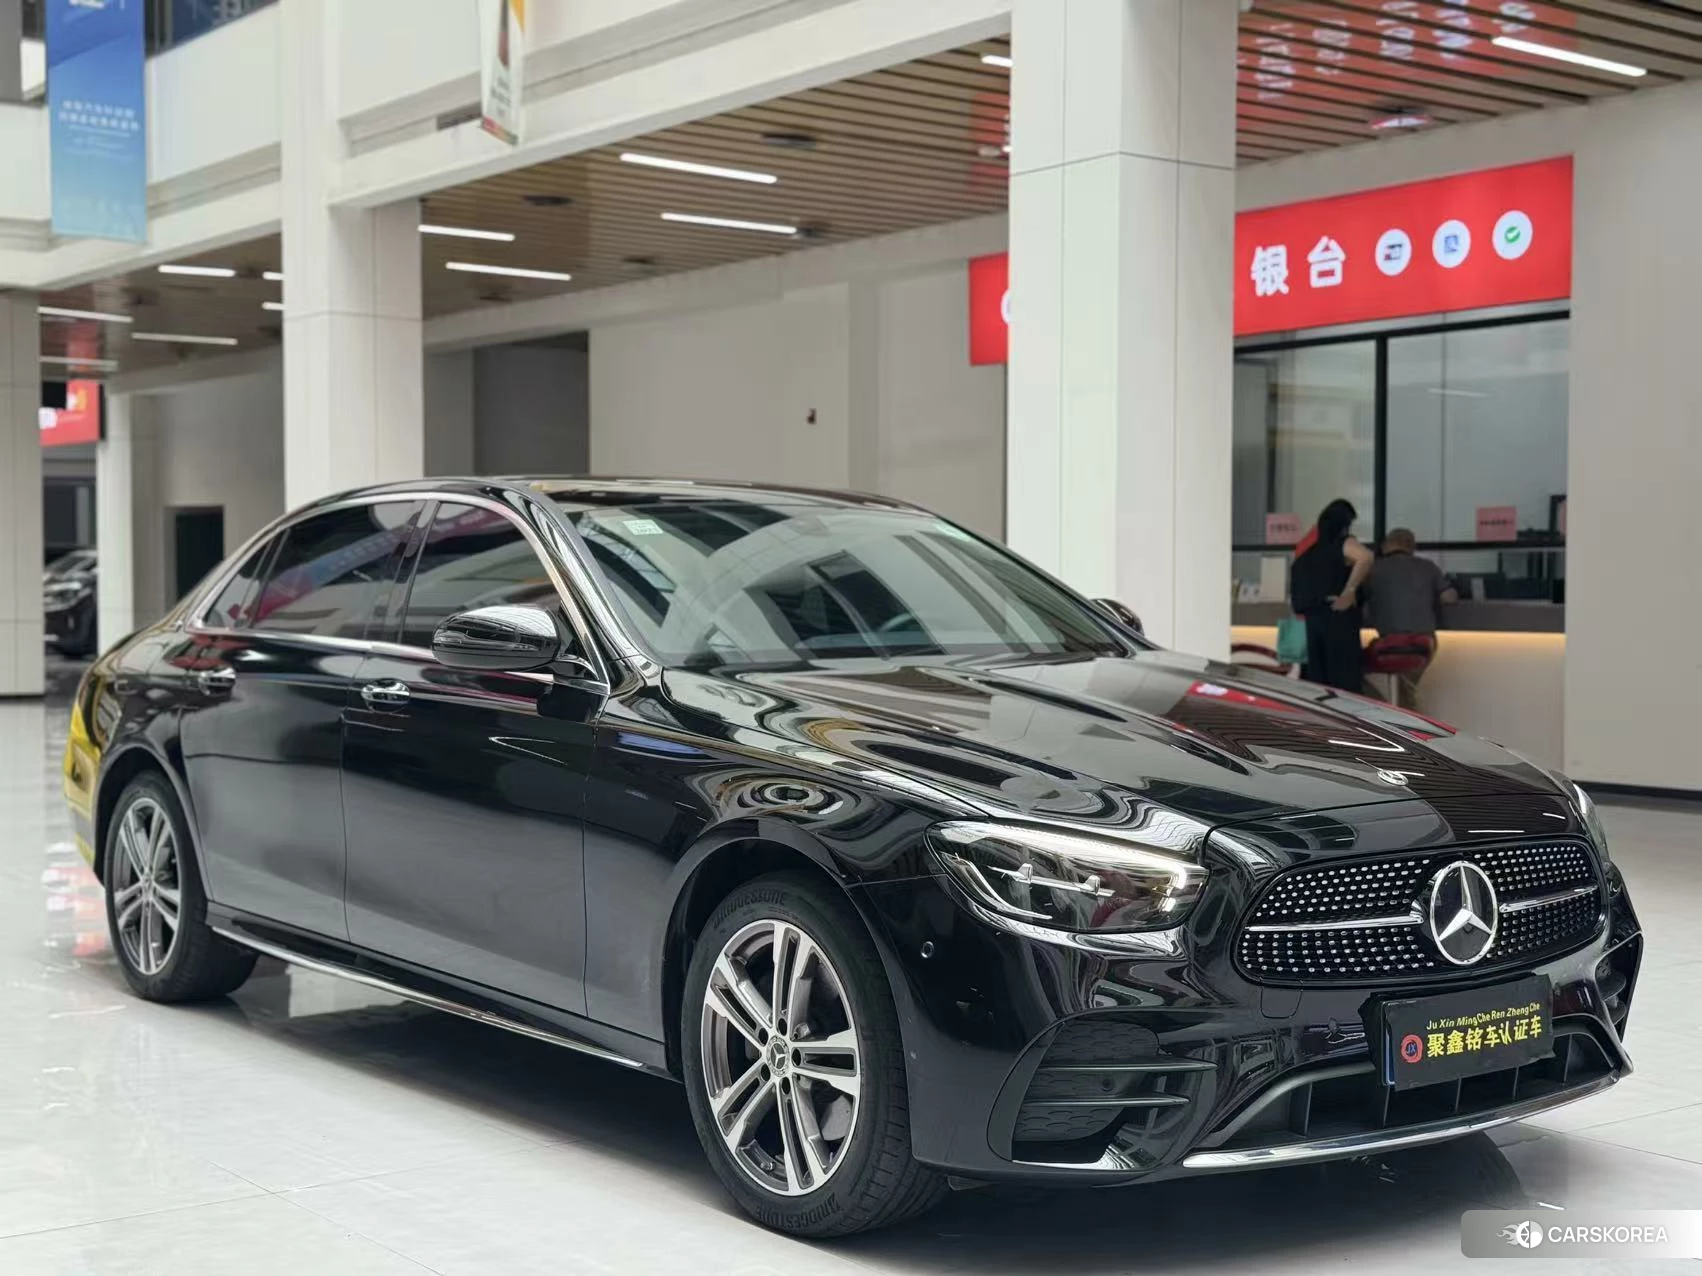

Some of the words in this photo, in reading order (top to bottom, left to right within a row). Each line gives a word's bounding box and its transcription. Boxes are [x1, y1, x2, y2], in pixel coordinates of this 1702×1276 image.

[1251, 235, 1346, 296] 银台
[1426, 1019, 1439, 1030] Ju
[1439, 1018, 1455, 1028] Xin
[1491, 1010, 1506, 1021] Ren
[1427, 1014, 1542, 1058] 聚鑫铭车认证车
